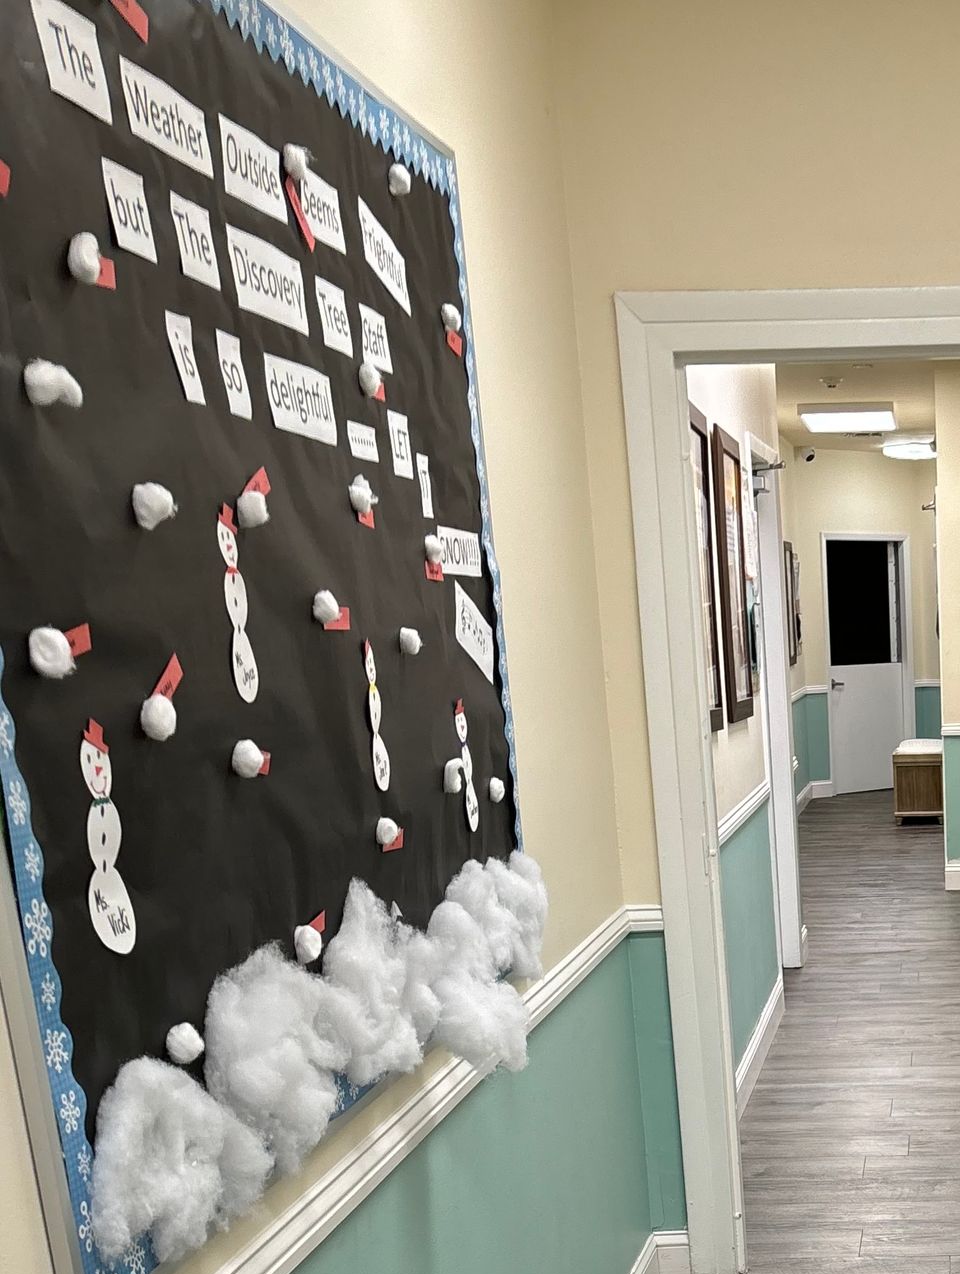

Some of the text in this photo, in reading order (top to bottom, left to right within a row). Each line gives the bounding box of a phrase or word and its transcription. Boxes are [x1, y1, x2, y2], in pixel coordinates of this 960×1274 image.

[48, 19, 95, 89] The
[124, 76, 204, 160] Weather
[226, 133, 280, 201] Outside
[304, 179, 339, 234] Seems
[110, 178, 386, 367] but The Discovery Tree Staff
[175, 333, 195, 377] is
[222, 357, 243, 393] so
[269, 376, 332, 424] delightful
[391, 431, 408, 462] LET
[420, 469, 429, 499] IT
